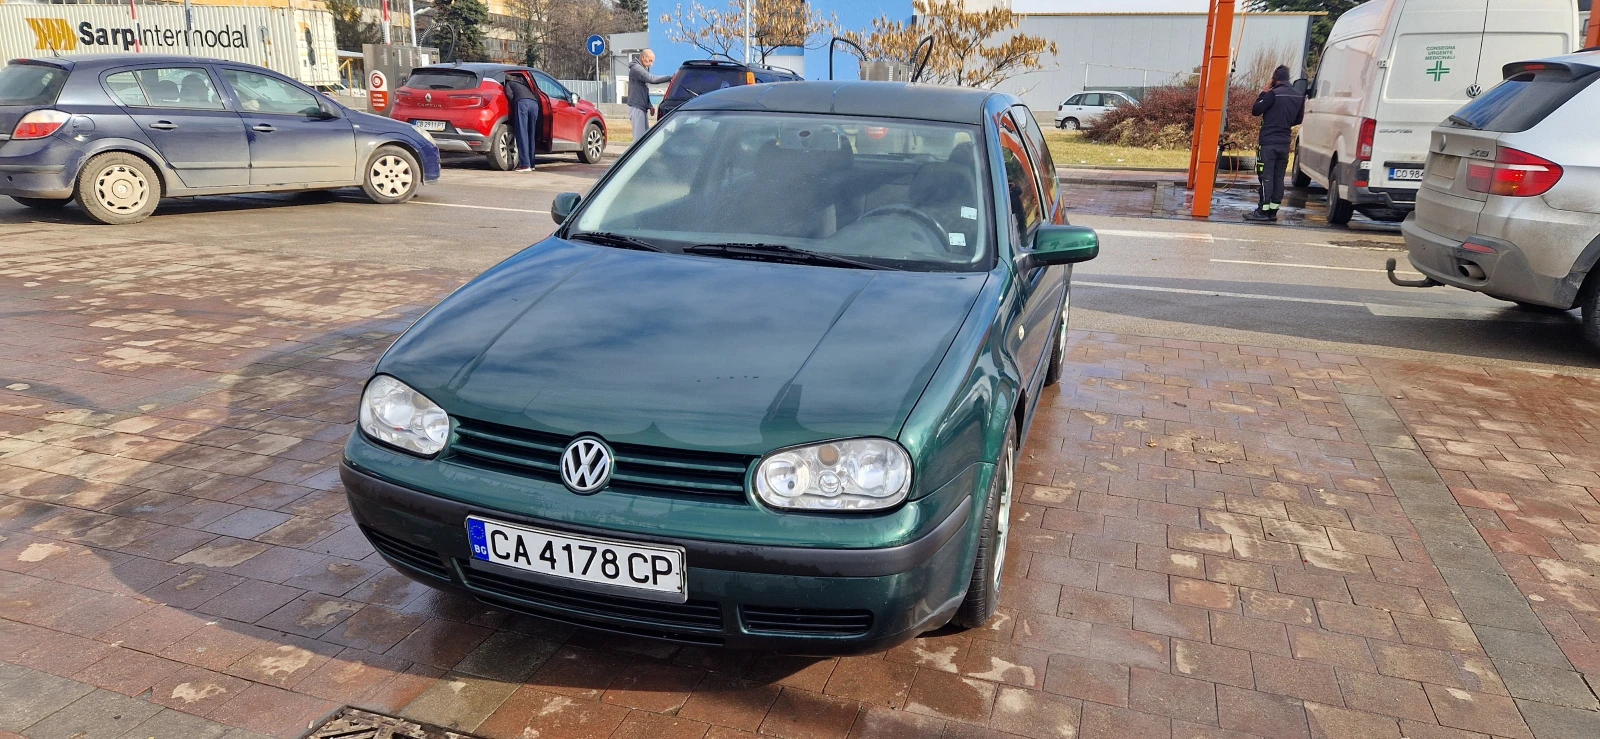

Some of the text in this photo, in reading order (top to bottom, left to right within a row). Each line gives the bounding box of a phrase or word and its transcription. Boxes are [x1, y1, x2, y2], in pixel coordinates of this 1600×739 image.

[1469, 149, 1490, 157] X5
[562, 439, 610, 490] VW
[474, 544, 487, 555] BG
[490, 529, 673, 586] CA 4178 CP
